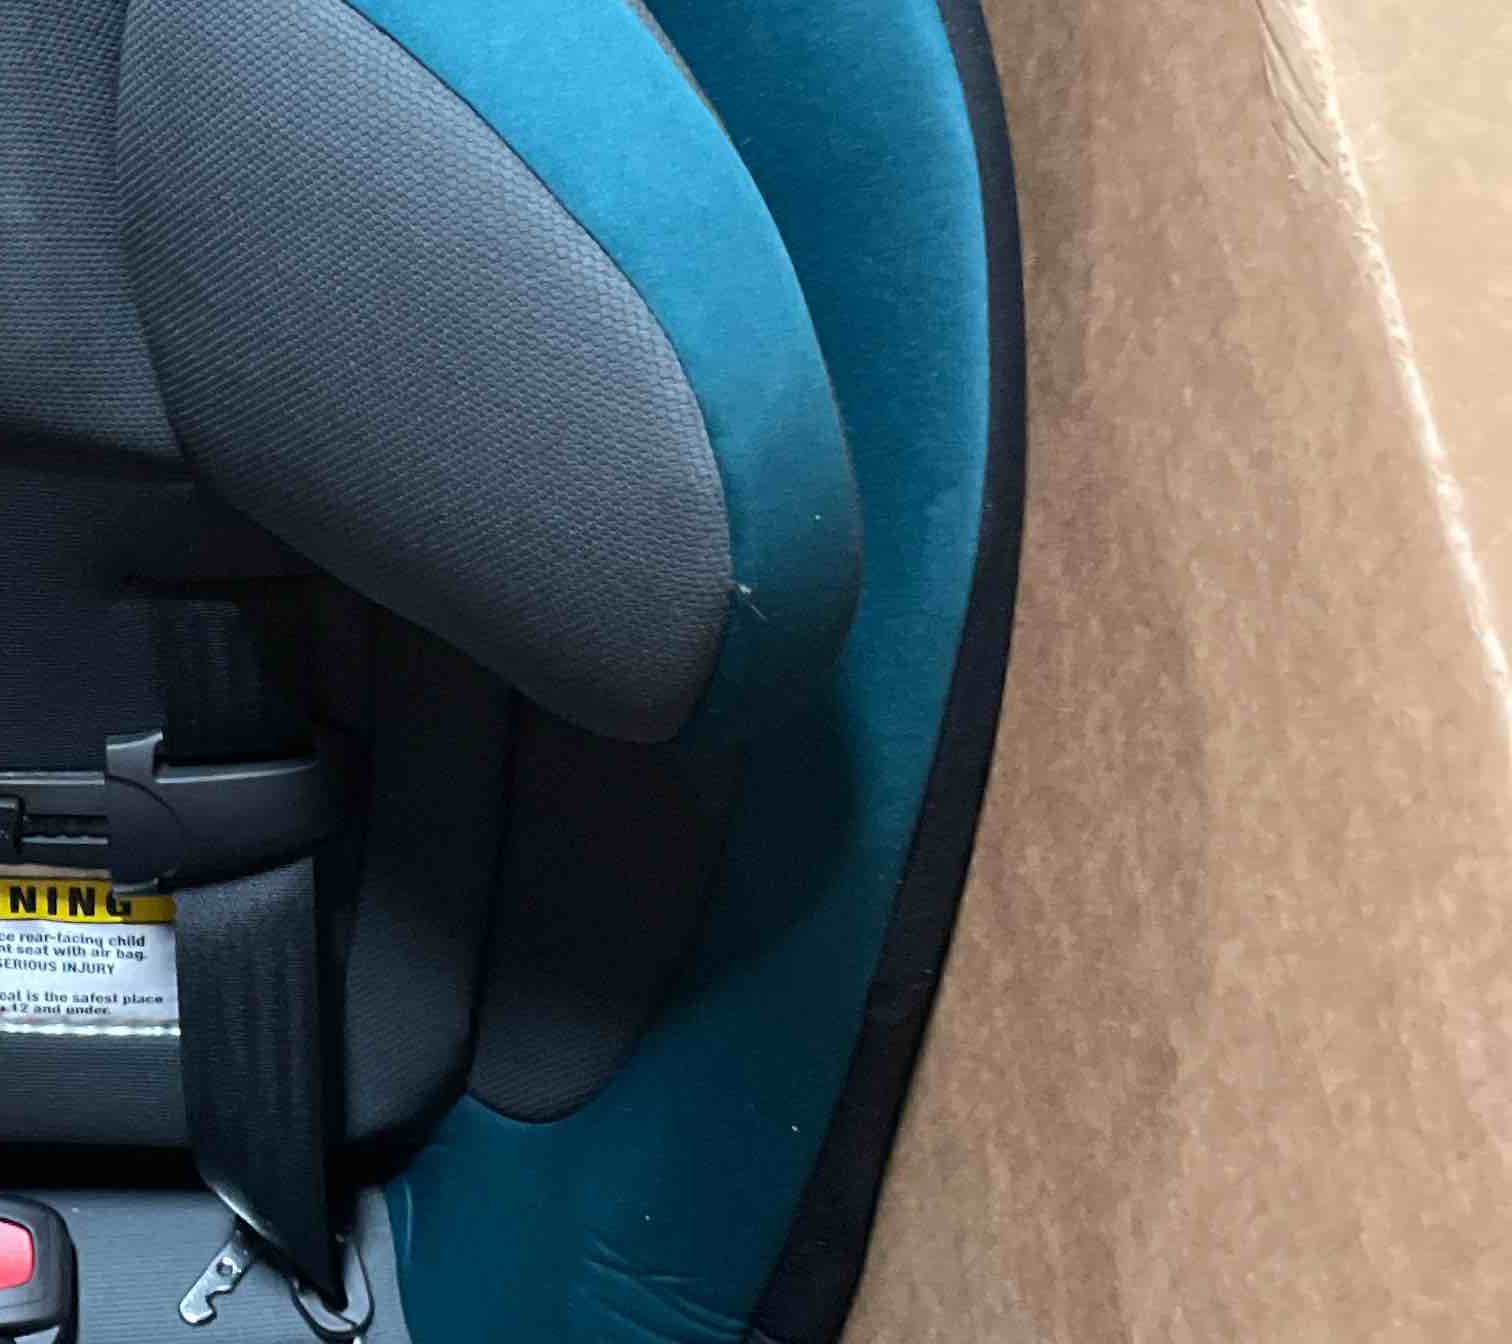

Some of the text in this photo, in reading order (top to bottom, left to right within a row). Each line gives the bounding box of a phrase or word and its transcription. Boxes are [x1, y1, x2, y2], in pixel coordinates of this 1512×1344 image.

[19, 932, 103, 948] rear-facing
[108, 935, 146, 947] child
[17, 944, 48, 955] seat
[54, 946, 87, 957] with
[91, 948, 111, 958] air
[62, 962, 115, 975] INJURY
[27, 991, 39, 1002] is
[45, 992, 67, 1003] the
[72, 993, 117, 1004] safest
[123, 995, 164, 1005] place
